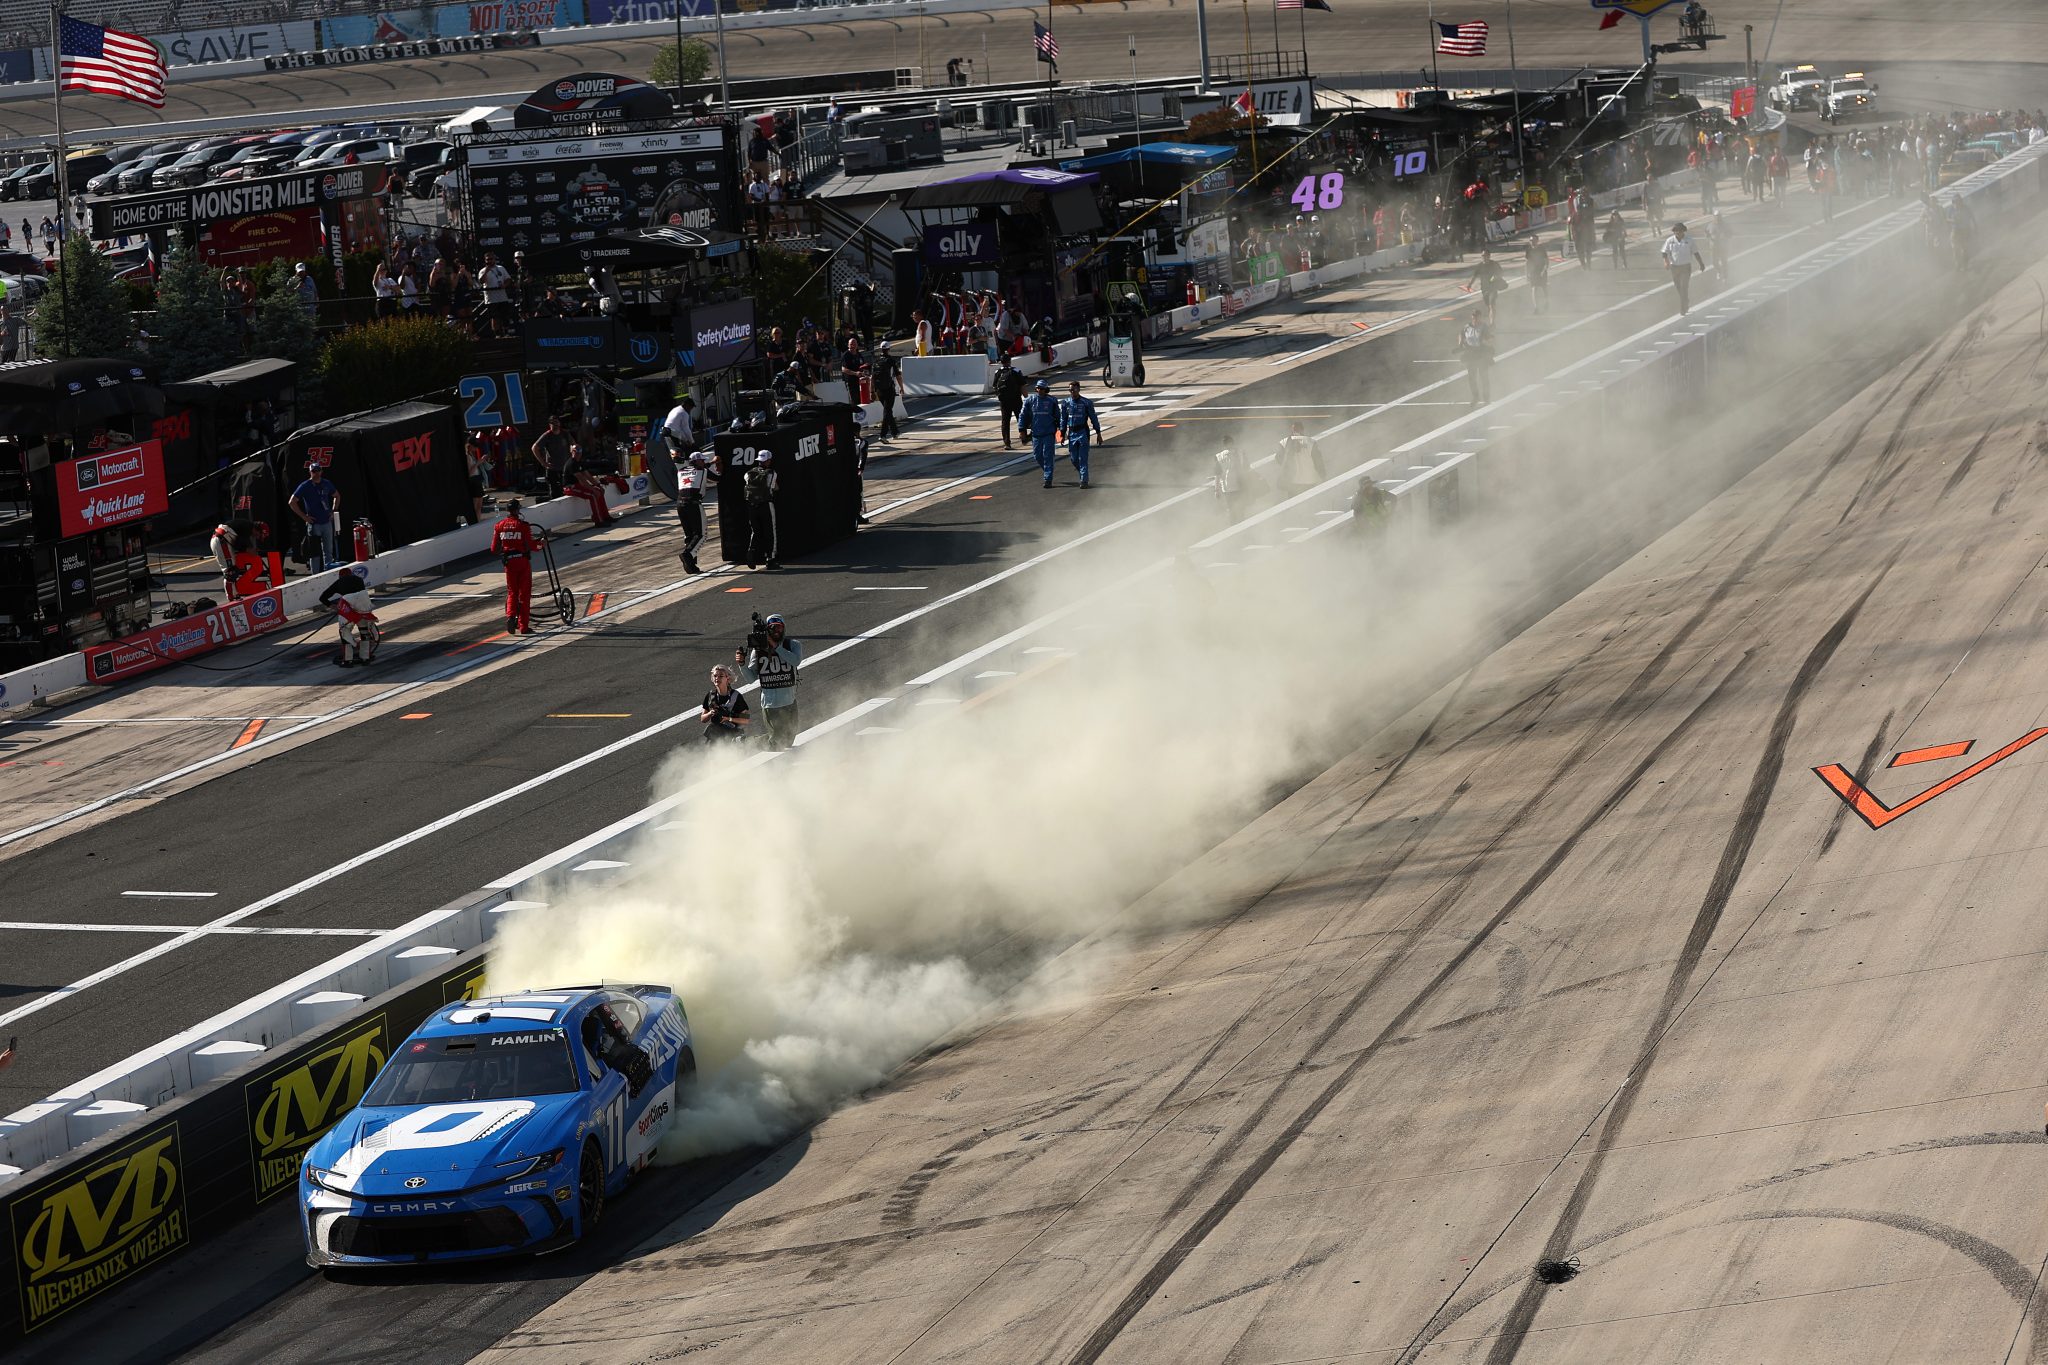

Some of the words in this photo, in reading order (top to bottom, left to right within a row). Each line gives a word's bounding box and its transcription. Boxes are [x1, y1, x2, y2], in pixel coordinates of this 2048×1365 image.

[518, 0, 558, 14] SOFT
[469, 5, 503, 32] NOT
[506, 13, 556, 30] DRINK
[271, 56, 316, 69] THE
[324, 42, 431, 65] MONSTER
[439, 37, 494, 54] MILE
[577, 79, 614, 93] DOVER
[552, 111, 593, 122] VICTORY
[596, 109, 622, 119] LANE
[641, 138, 669, 148] xfinity
[1654, 121, 1685, 146] 71
[1394, 151, 1427, 177] 10
[337, 170, 363, 189] DOVER
[113, 207, 146, 227] HOME
[149, 205, 164, 221] OF
[165, 201, 187, 219] THE
[192, 184, 273, 221] MONSTER
[277, 177, 316, 208] MILE
[573, 197, 621, 208] ALL-STAR
[1291, 172, 1345, 212] 48
[583, 206, 611, 216] RACE
[683, 208, 710, 228] DOVER
[247, 228, 266, 237] FIRE
[939, 230, 982, 256] ally
[331, 225, 344, 267] DOVER
[592, 248, 631, 257] TRACKHOUSE
[697, 323, 751, 347] SafetyCulture
[458, 373, 529, 429] 21
[304, 446, 334, 469] 35
[731, 447, 756, 466] 20
[794, 433, 820, 461] JGR
[101, 457, 139, 477] Motorcraft
[96, 497, 121, 517] Quick
[122, 493, 145, 509] Lane
[233, 551, 286, 596] 21
[256, 600, 273, 614] Ford
[206, 611, 231, 644] 21
[115, 646, 150, 665] Motorcraft
[491, 1033, 557, 1046] HAMLIN
[606, 1092, 624, 1175] 11
[373, 1202, 456, 1214] CAMRY
[27, 1247, 129, 1322] MECHANIX
[129, 1213, 183, 1267] WEAR
